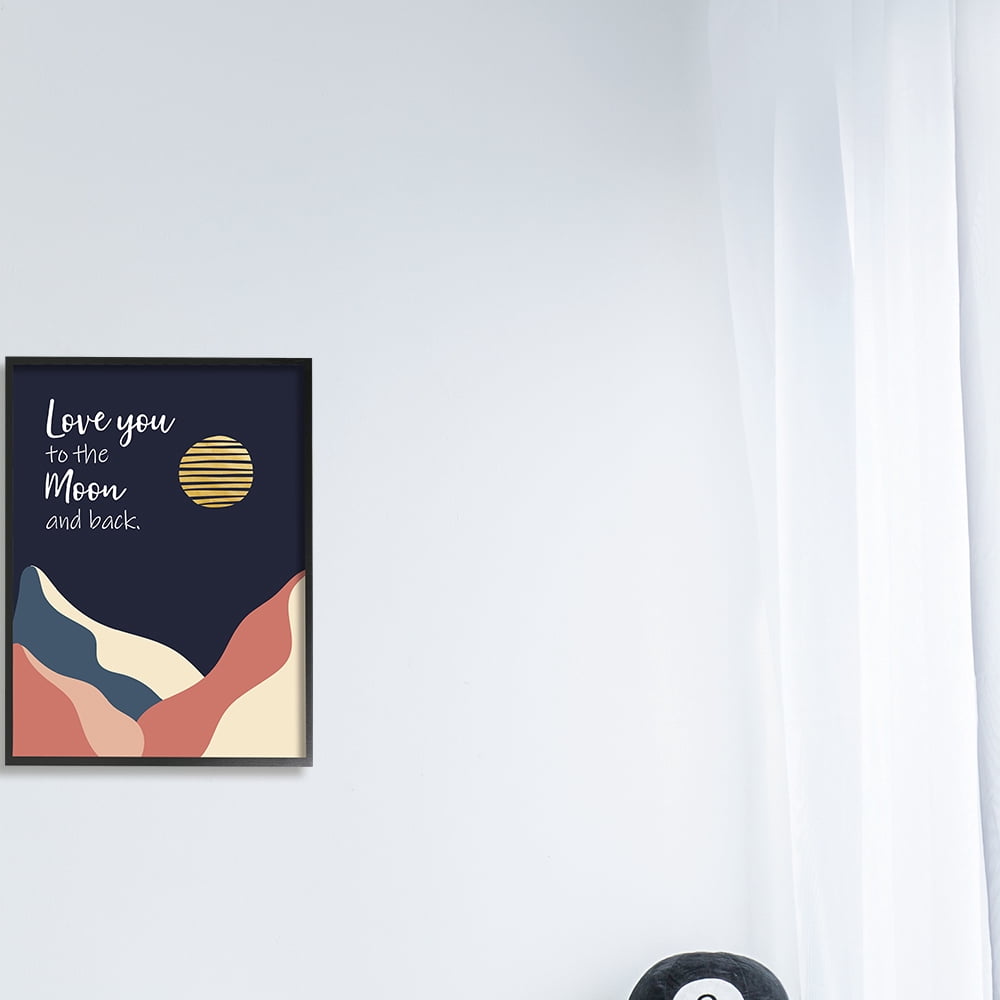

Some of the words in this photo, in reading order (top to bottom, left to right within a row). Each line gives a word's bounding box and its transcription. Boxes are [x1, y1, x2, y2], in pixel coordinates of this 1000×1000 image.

[46, 398, 112, 439] Love
[117, 413, 176, 448] you
[46, 446, 69, 464] to
[73, 443, 109, 464] the
[45, 468, 128, 504] Moon
[46, 508, 82, 531] and
[89, 508, 141, 531] back.
